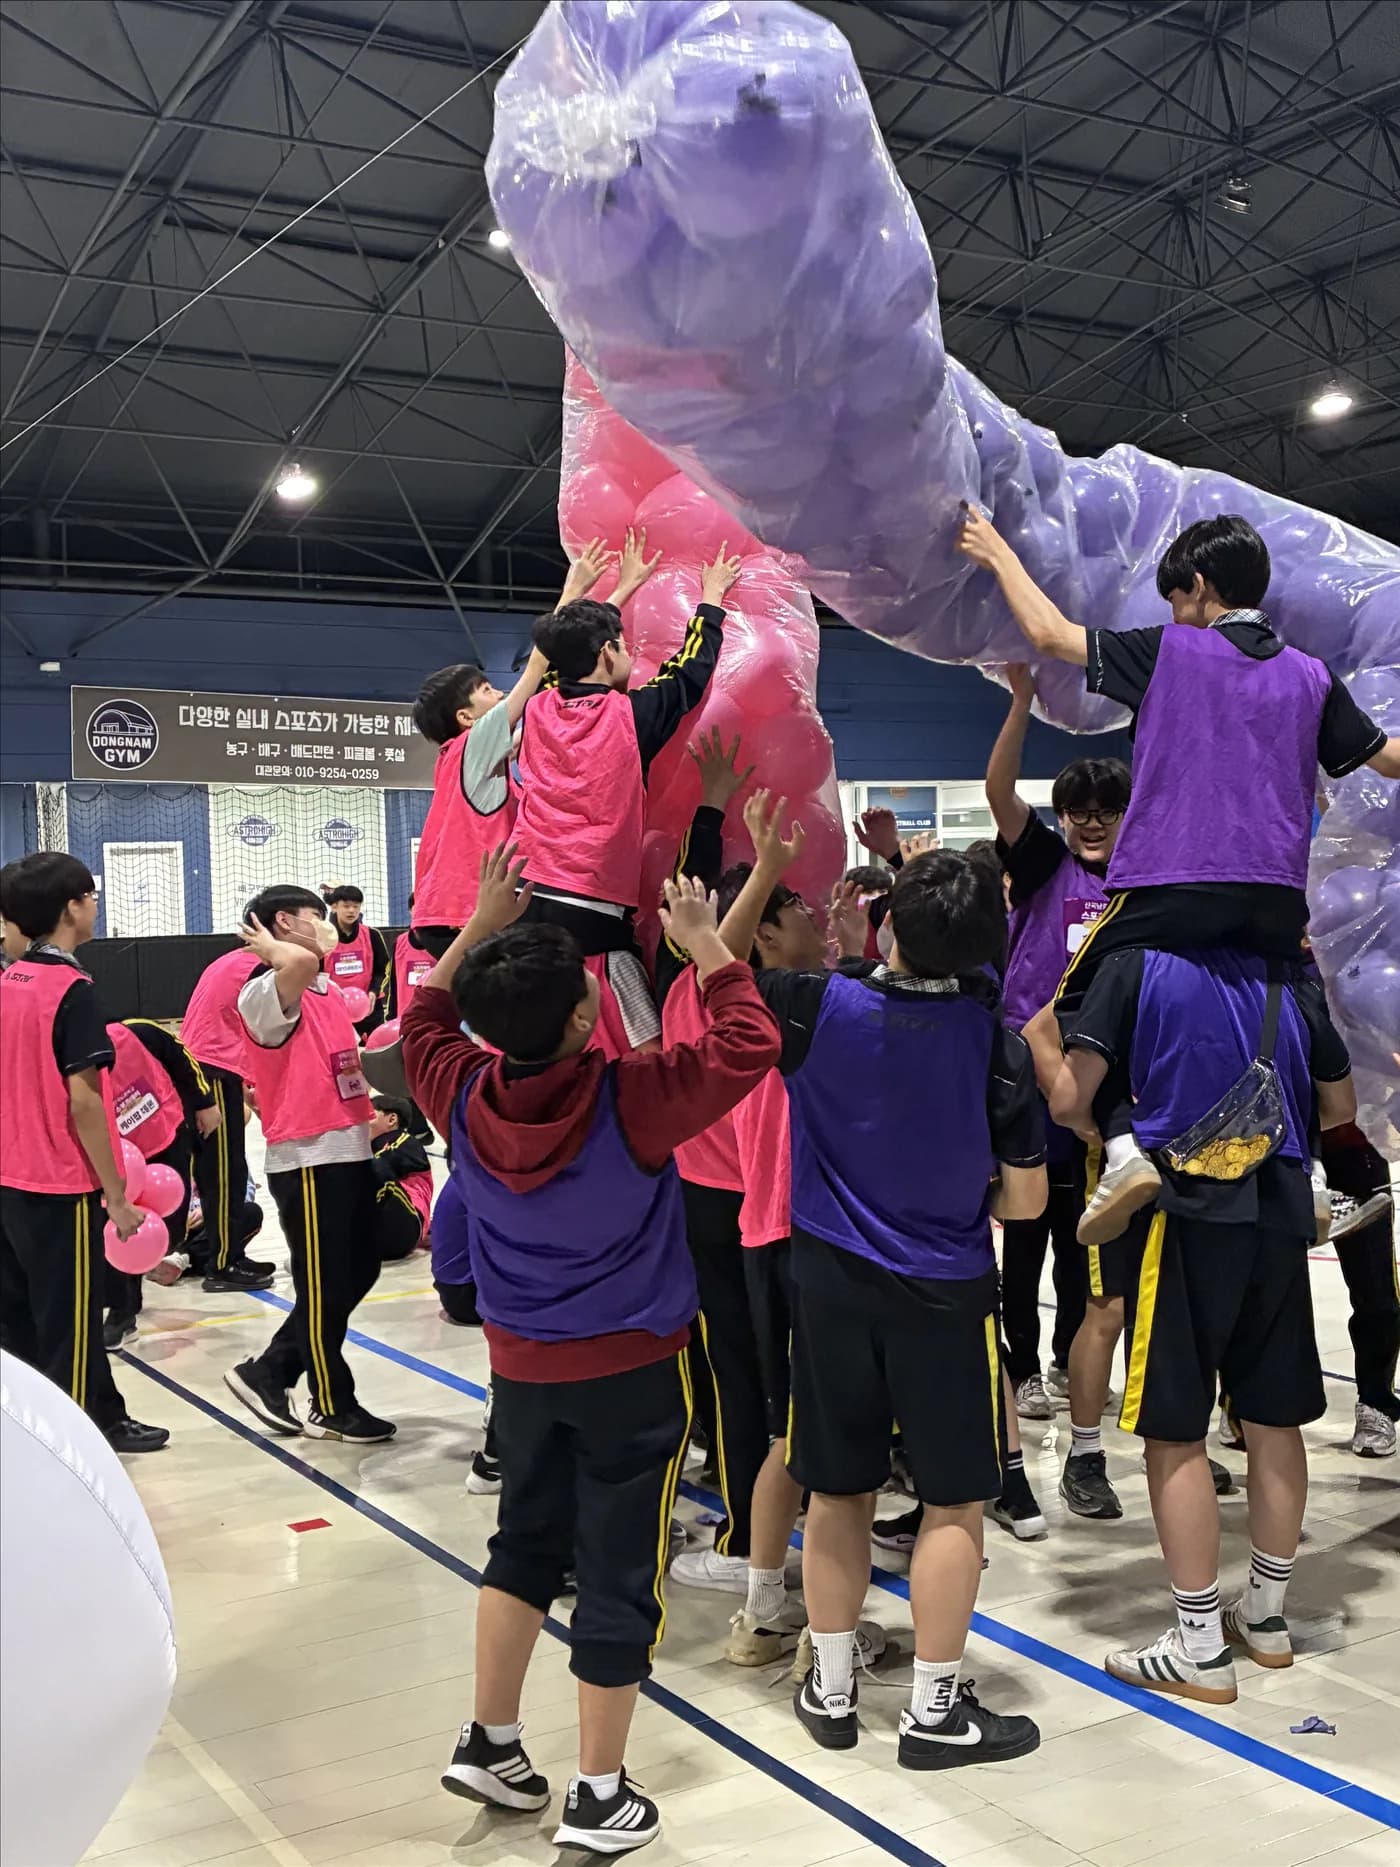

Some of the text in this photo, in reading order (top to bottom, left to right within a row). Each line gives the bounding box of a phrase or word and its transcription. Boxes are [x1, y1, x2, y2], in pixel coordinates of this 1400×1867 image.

[179, 705, 231, 728] 다양한
[236, 708, 269, 730] 실내
[274, 710, 338, 733] 스포츠가
[343, 713, 390, 736] 가능한
[92, 735, 152, 749] DONGNAM
[104, 749, 141, 763] GYM
[226, 741, 405, 762] 농구 배구 배드민턴 피클볼 풋살
[255, 764, 380, 780] 대관문의: 010-9254-0259
[829, 1697, 847, 1707] NIKE
